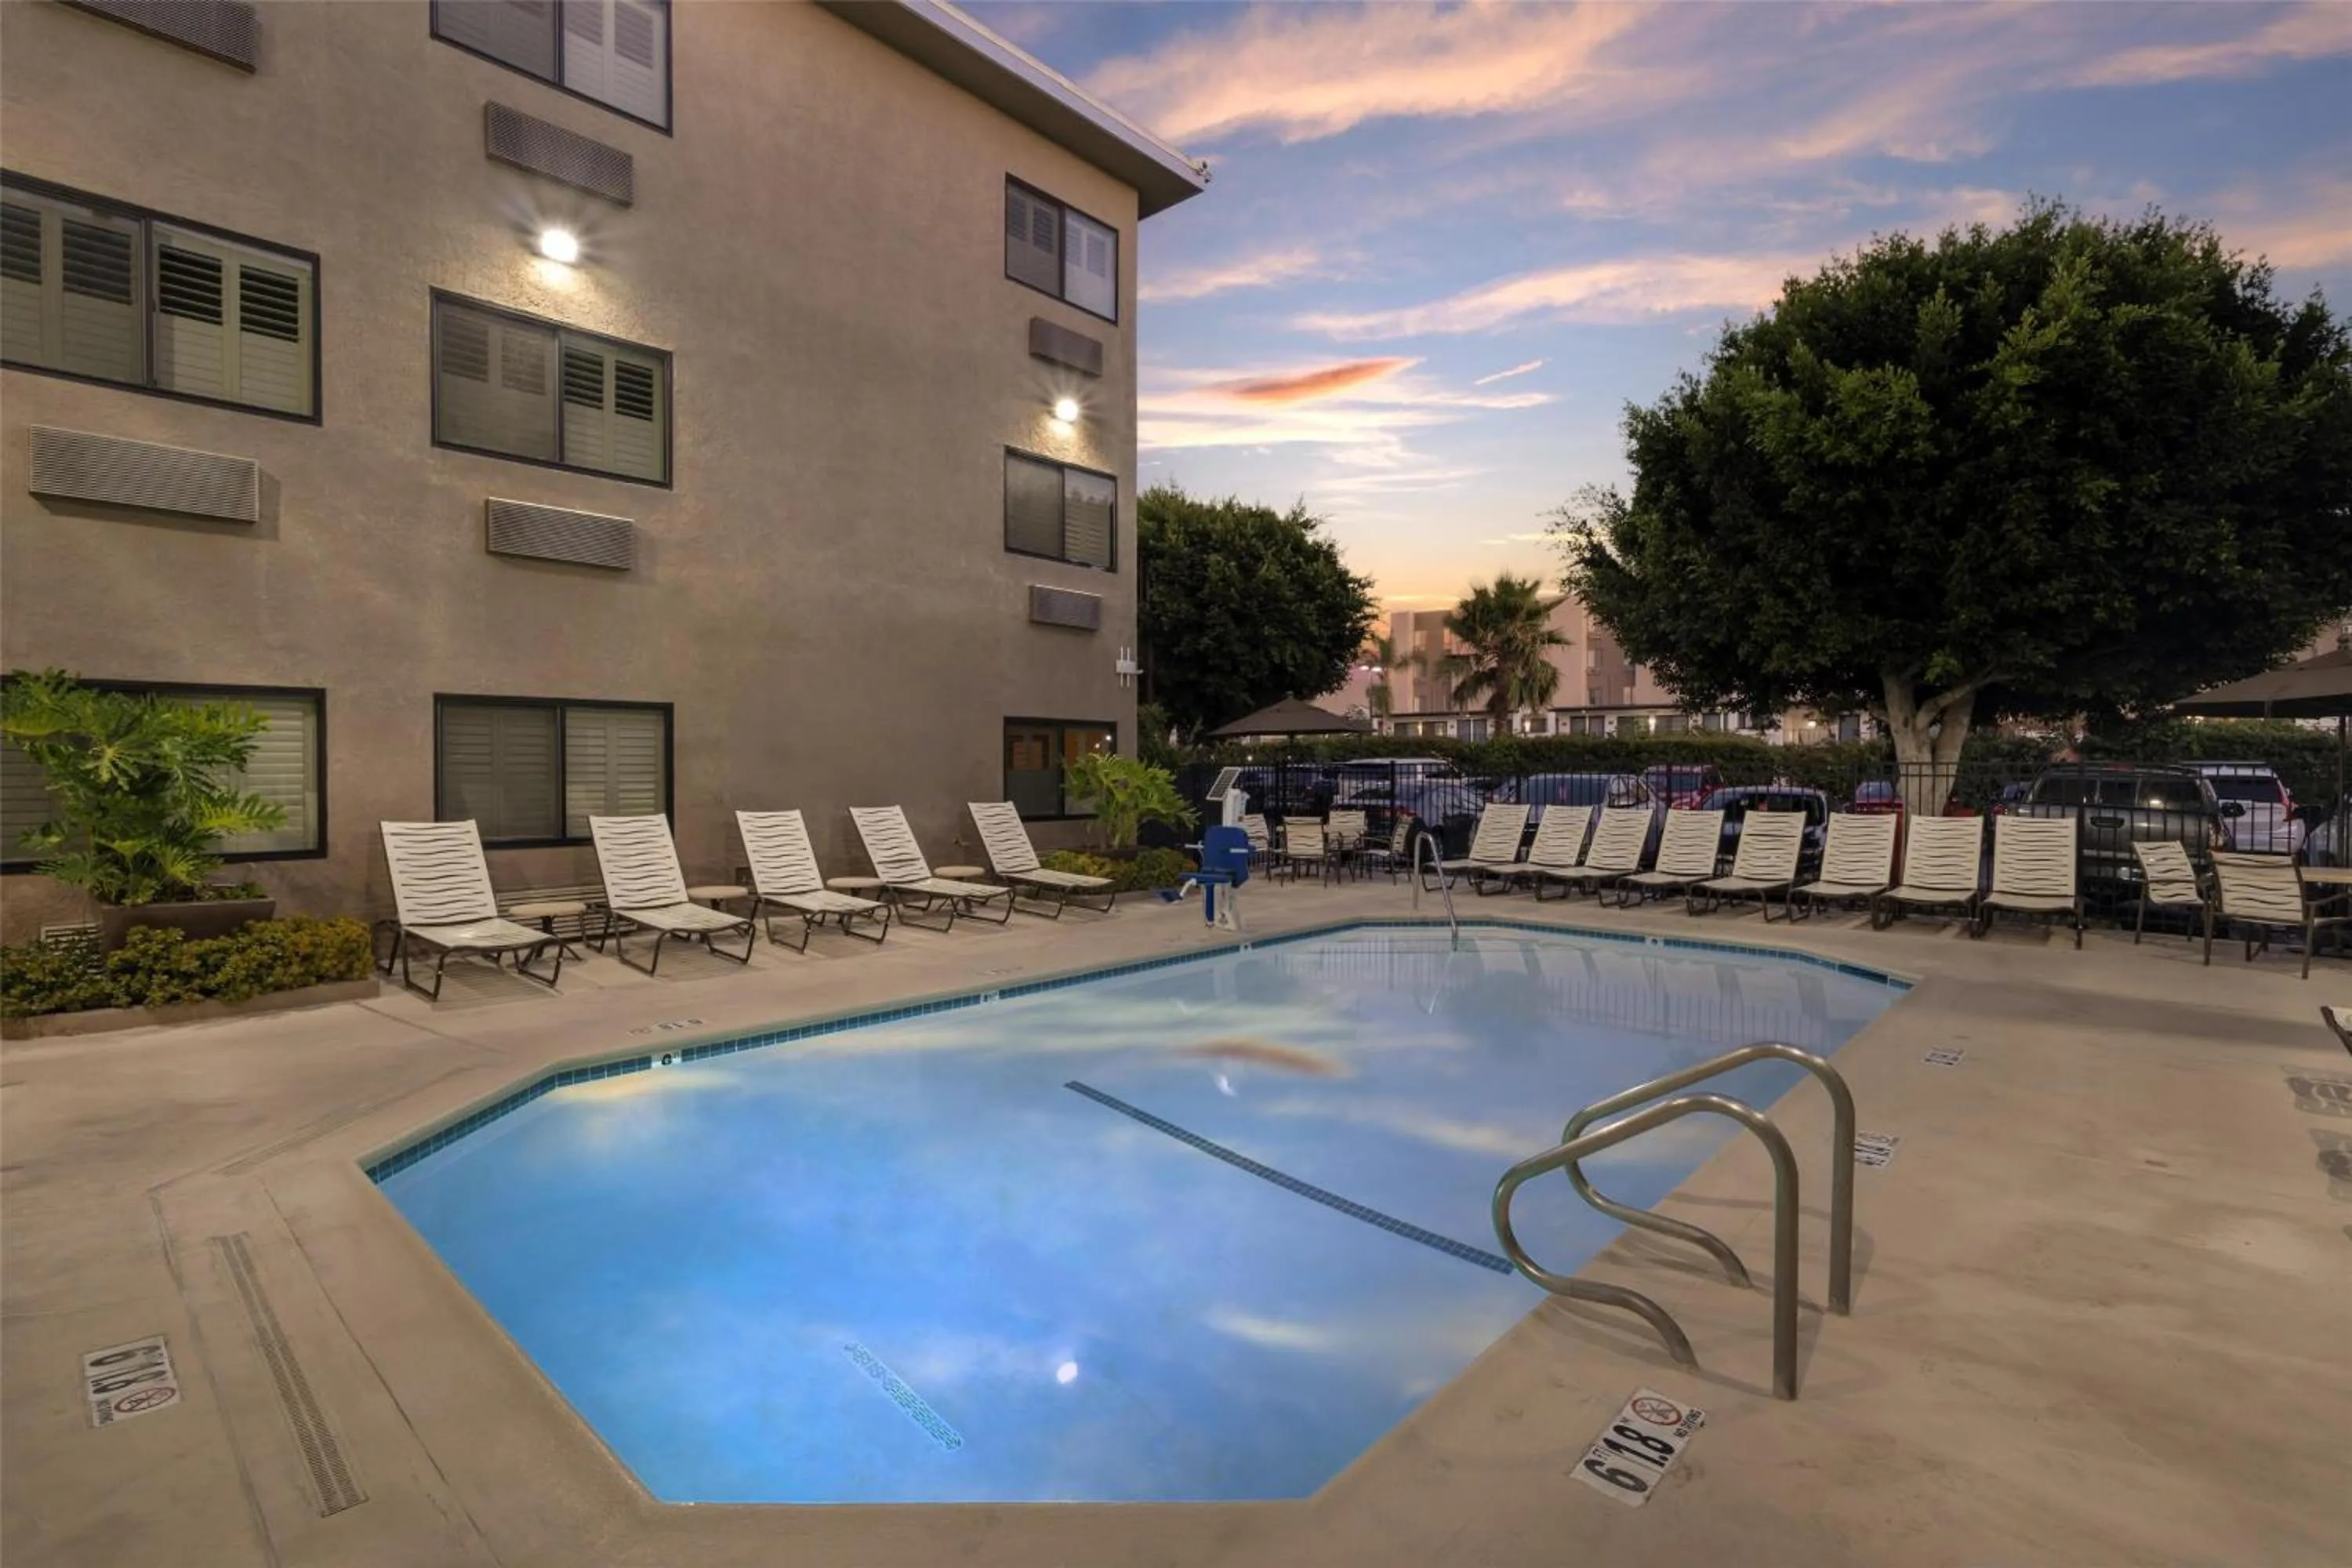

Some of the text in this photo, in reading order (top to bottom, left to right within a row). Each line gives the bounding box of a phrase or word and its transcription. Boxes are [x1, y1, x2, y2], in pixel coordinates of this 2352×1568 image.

[89, 1345, 162, 1367] 6
[1603, 1425, 1675, 1468] 1.8
[1584, 1458, 1648, 1493] 6
